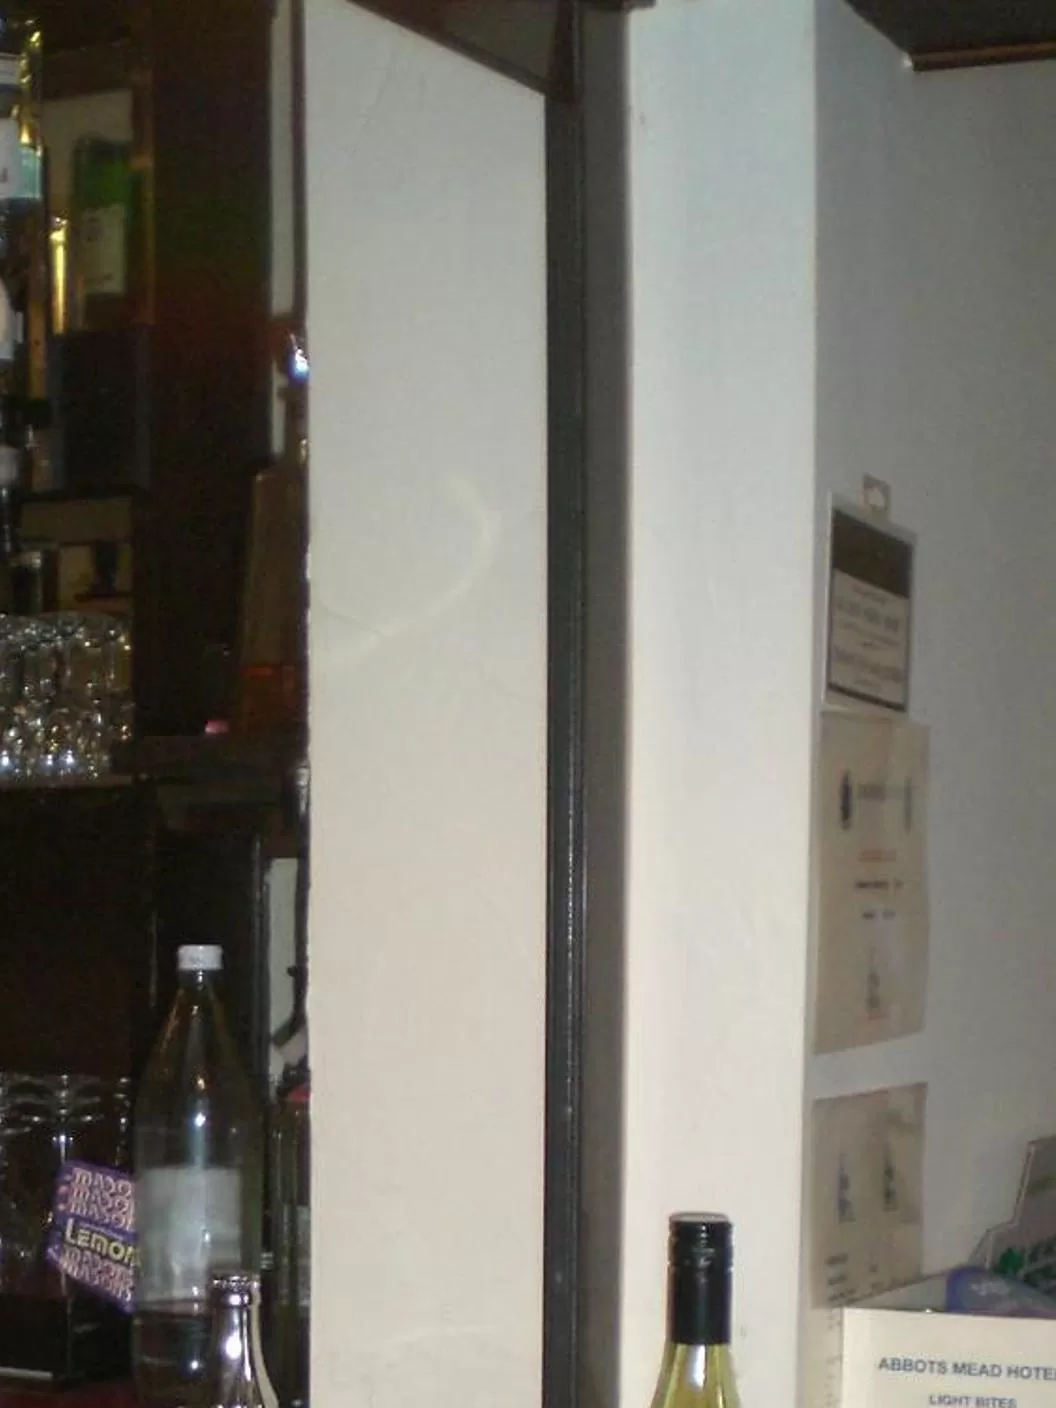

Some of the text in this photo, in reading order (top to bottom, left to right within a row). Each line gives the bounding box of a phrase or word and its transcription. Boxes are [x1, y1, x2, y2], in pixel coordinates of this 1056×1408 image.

[878, 1357, 948, 1376] ABBOTS
[952, 1361, 1002, 1378] MEAD
[928, 1394, 972, 1408] LIGHT
